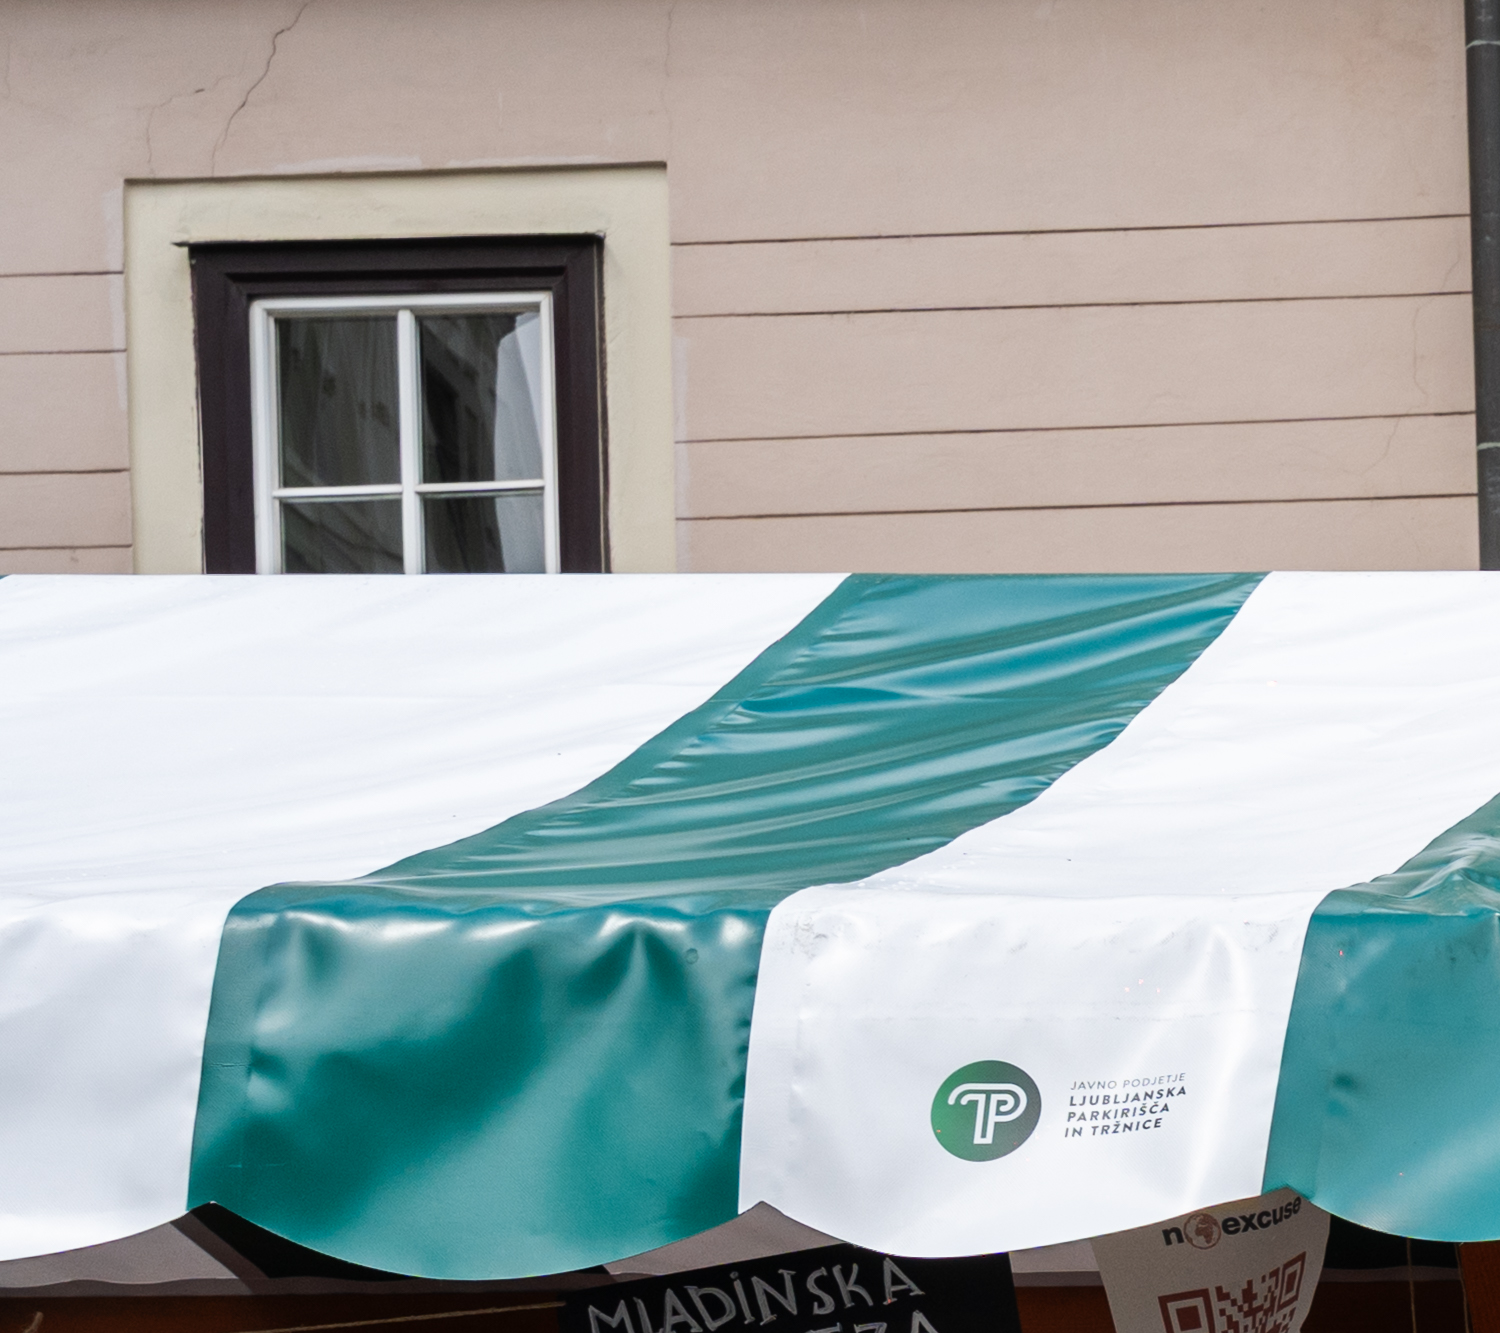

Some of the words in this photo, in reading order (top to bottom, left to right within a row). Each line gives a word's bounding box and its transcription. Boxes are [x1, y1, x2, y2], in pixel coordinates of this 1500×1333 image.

[1070, 1080, 1117, 1091] JAVNO
[1123, 1072, 1186, 1089] PODJETJE
[1069, 1085, 1187, 1107] LJUBLJANSKA
[1066, 1102, 1170, 1122] PARKIRIŠČA
[1064, 1127, 1083, 1138] IN
[1090, 1117, 1163, 1136] TRŽNICE
